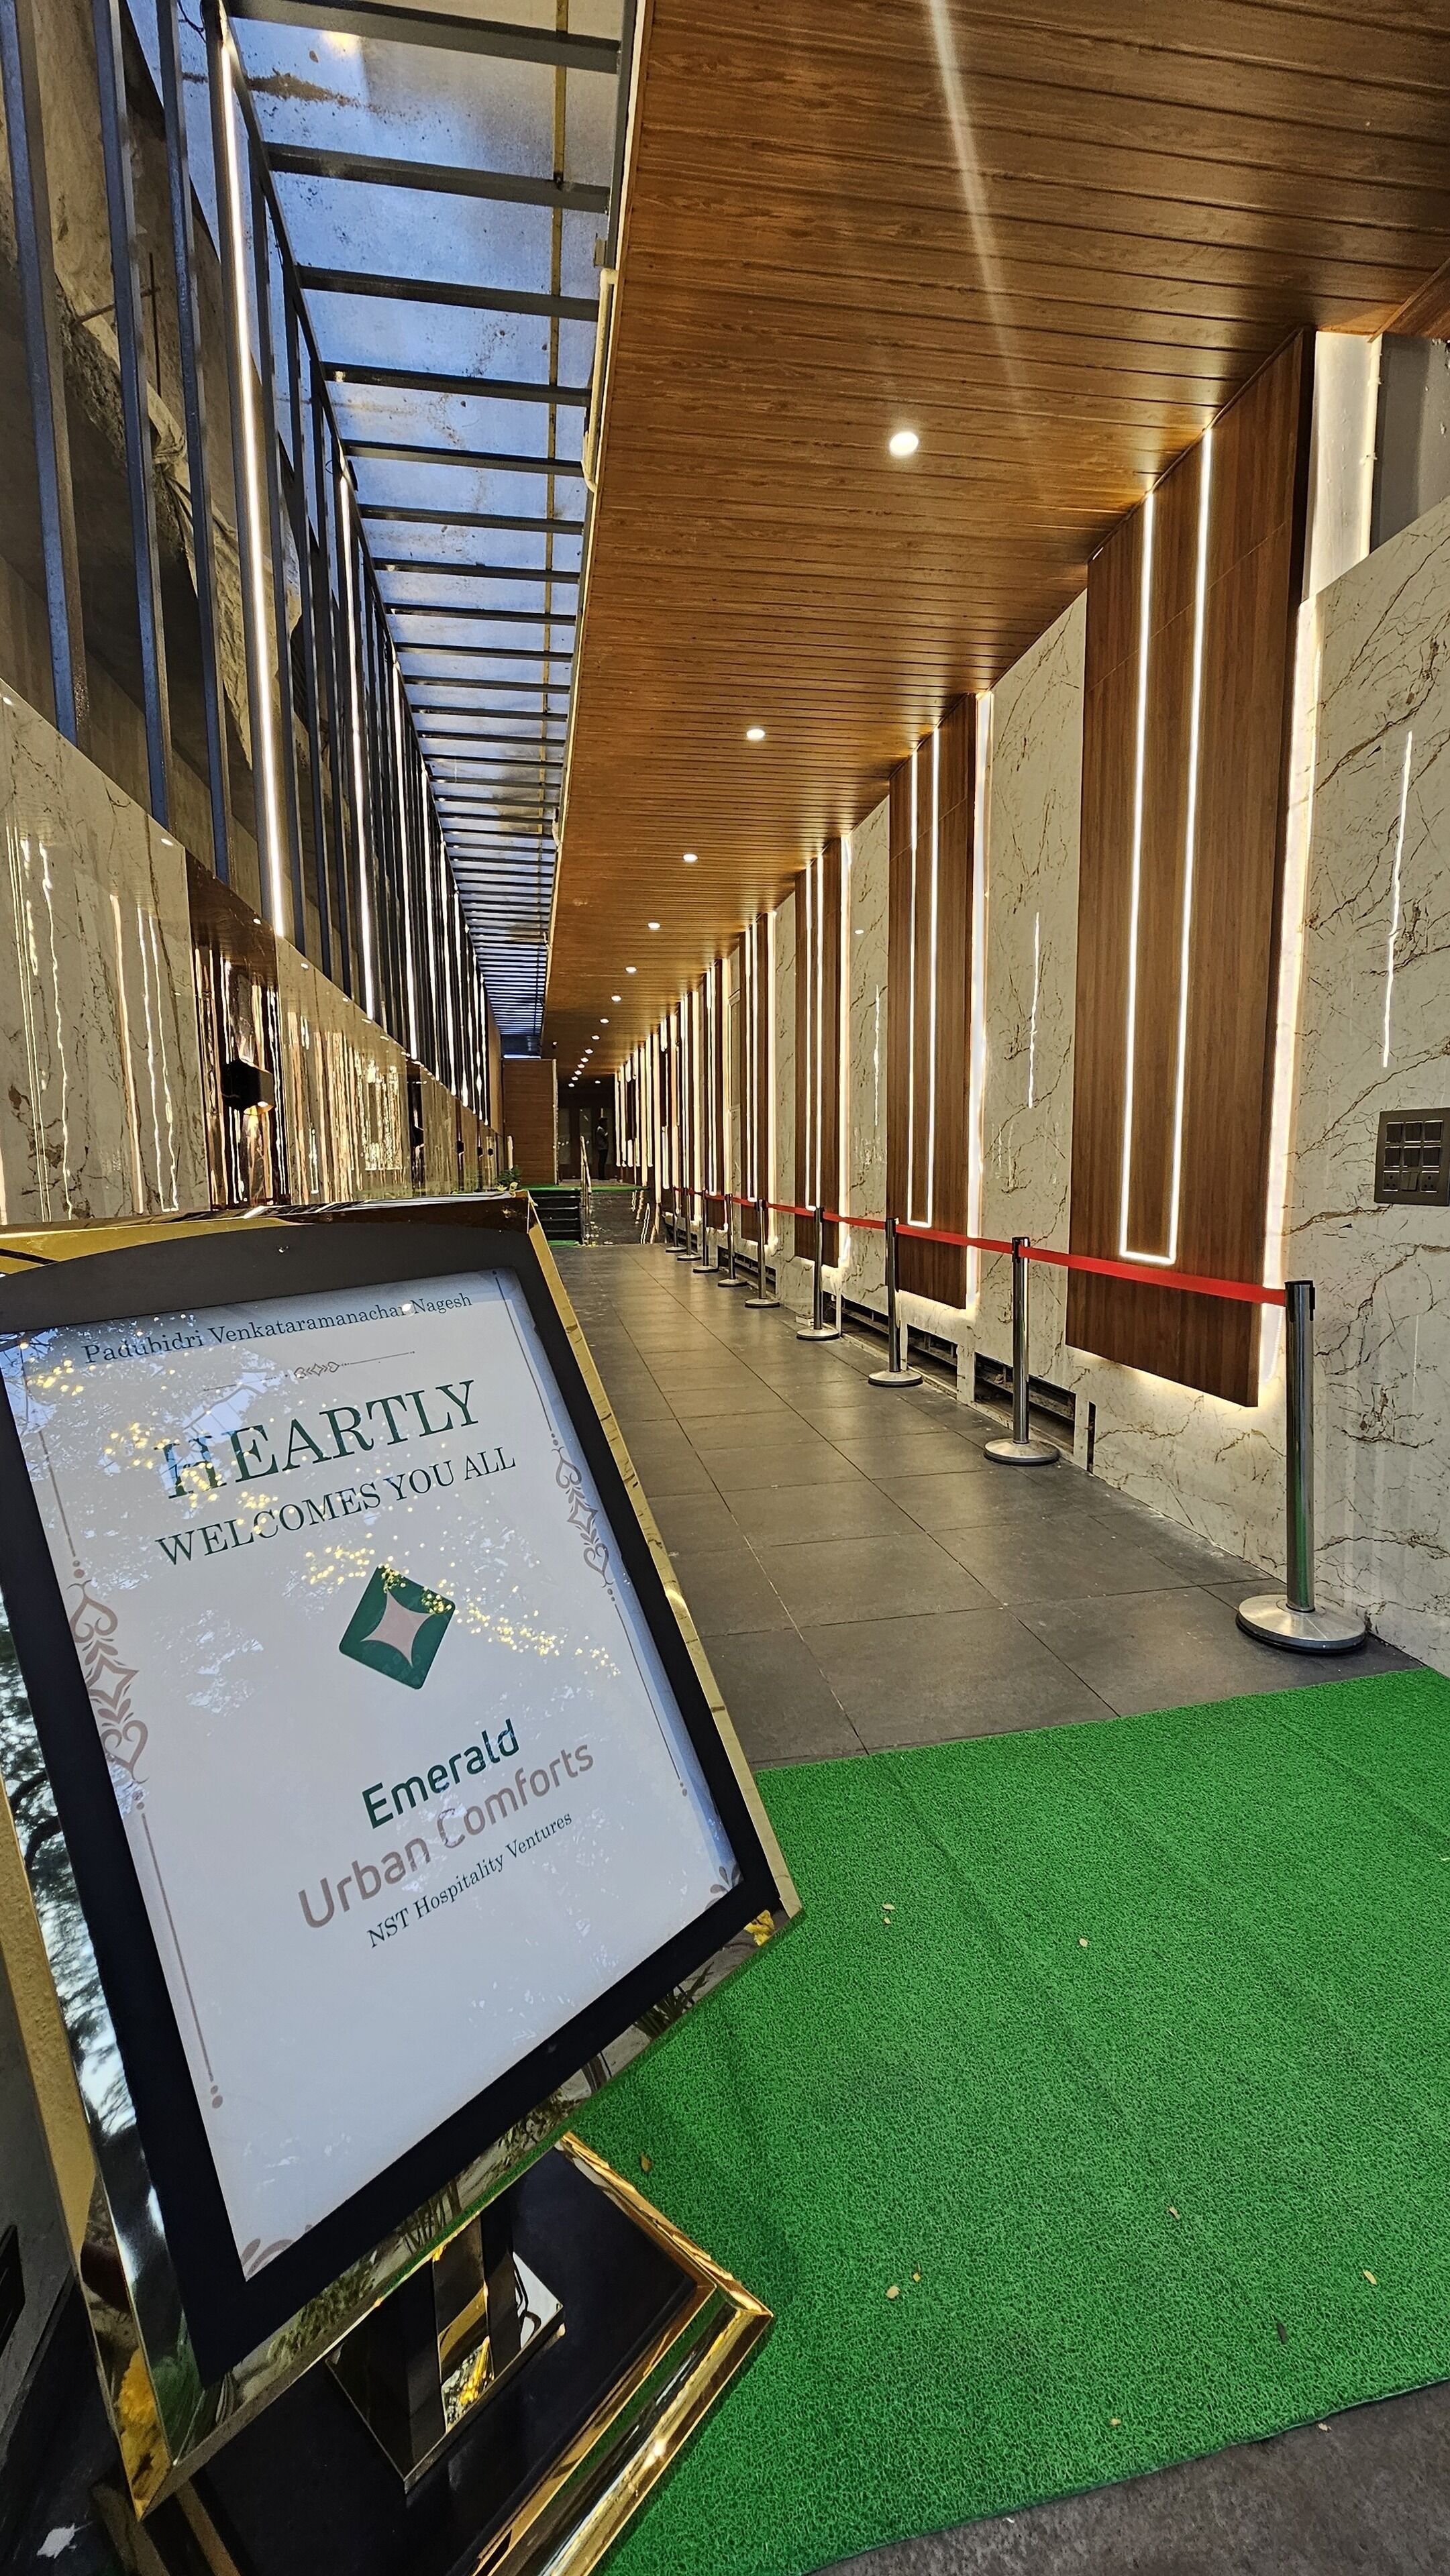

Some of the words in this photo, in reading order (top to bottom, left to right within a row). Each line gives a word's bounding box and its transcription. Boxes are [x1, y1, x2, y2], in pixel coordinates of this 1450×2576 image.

[410, 1293, 472, 1314] Nagesh
[154, 1379, 479, 1499] HEARTLY
[155, 1483, 381, 1566] WELCOMES
[383, 1460, 455, 1501] YOU
[464, 1446, 516, 1481] ALL
[362, 1718, 520, 1829] Emerald
[298, 1837, 431, 1929] Urban
[436, 1744, 594, 1849] Comforts
[366, 1908, 410, 1948] NST
[416, 1854, 504, 1919] Hospitality
[505, 1811, 572, 1858] Ventures
